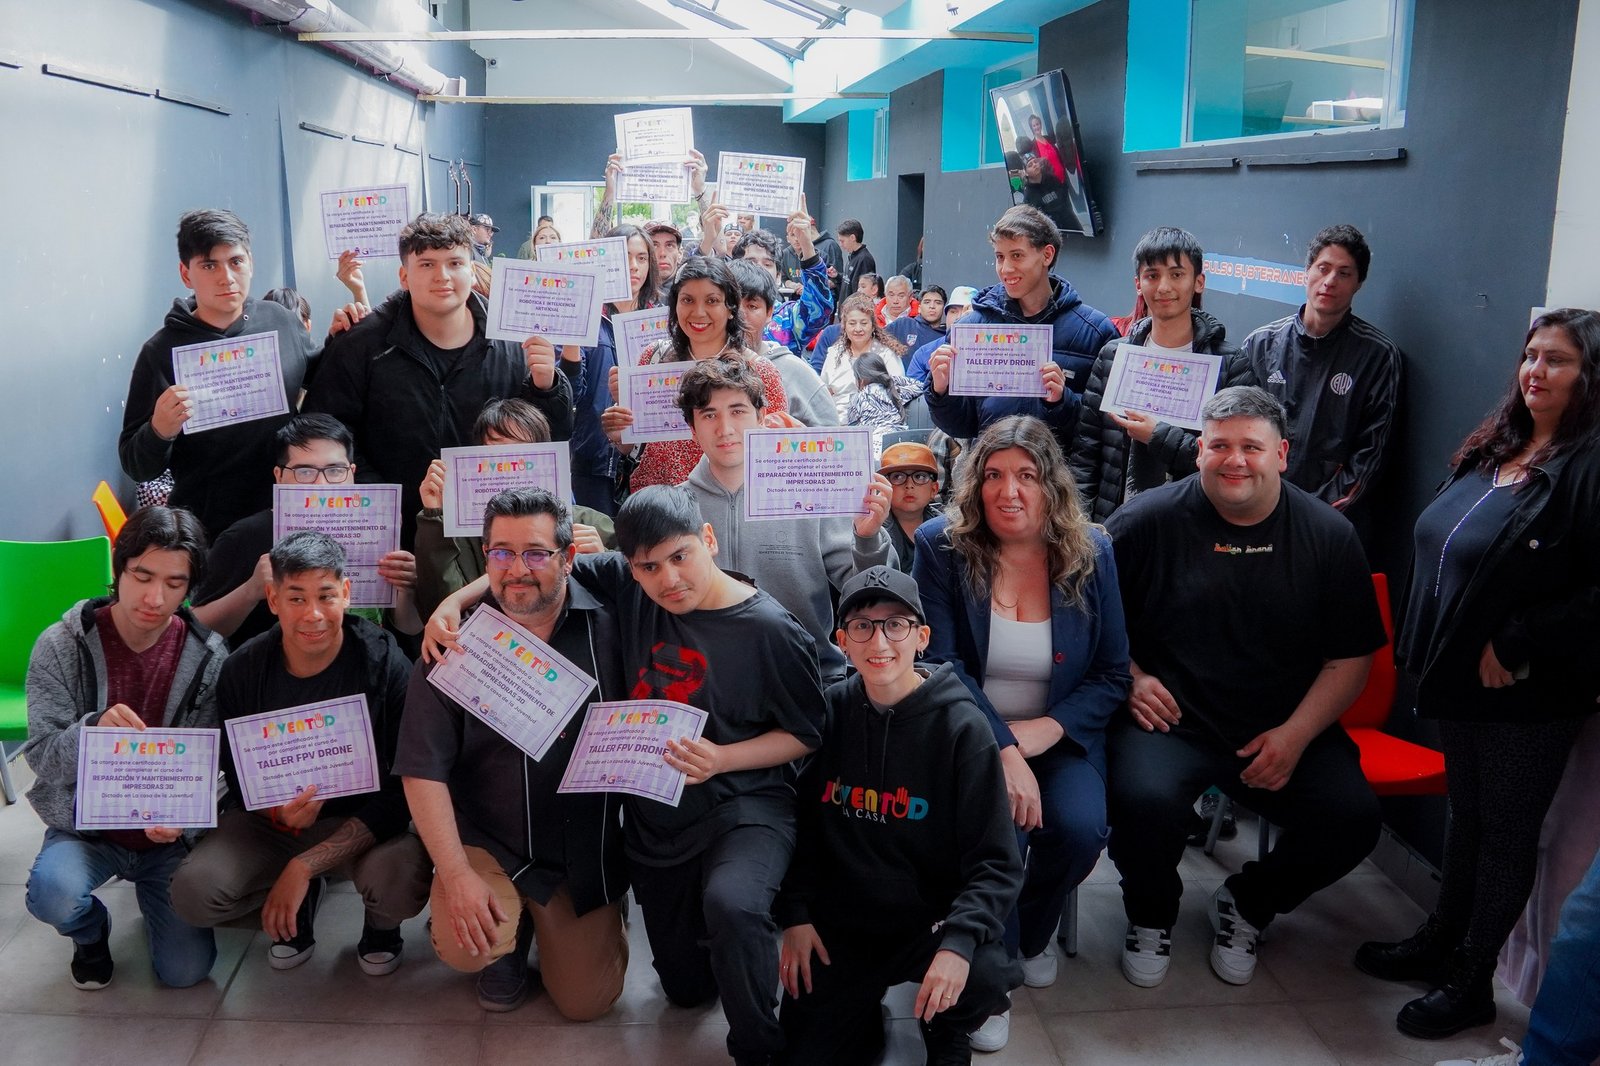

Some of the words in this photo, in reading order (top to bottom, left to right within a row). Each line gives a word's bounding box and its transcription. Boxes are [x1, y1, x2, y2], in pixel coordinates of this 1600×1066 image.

[738, 160, 784, 173] JUVENTUD
[338, 193, 387, 208] JUVENTUD
[559, 246, 605, 260] JUVENTUD
[524, 276, 575, 289] JUVENTUD
[975, 332, 1028, 344] JUVENTUD
[200, 346, 255, 366] JUVENTUD
[1143, 360, 1190, 375] JUVENTUD
[776, 436, 844, 453] JUVENTUD
[477, 459, 534, 473] JUVENTUD
[305, 493, 371, 508] JUVENTUD
[493, 631, 558, 682] JUVENTUD
[461, 644, 498, 673] REPARACIÓN
[501, 674, 548, 711] MANTENIMIENTO
[480, 669, 517, 698] IMPRESORAS
[516, 696, 525, 704] 3D
[262, 712, 335, 739] JUVENTUD
[607, 709, 668, 726] JUVENTUD
[113, 737, 186, 755] JUVENTUD
[589, 745, 615, 754] TALLER
[257, 756, 294, 769] TALLER
[296, 751, 316, 762] FPV
[318, 744, 353, 758] DRONE
[821, 776, 929, 820] JUVENTUD
[856, 808, 886, 824] CASA
